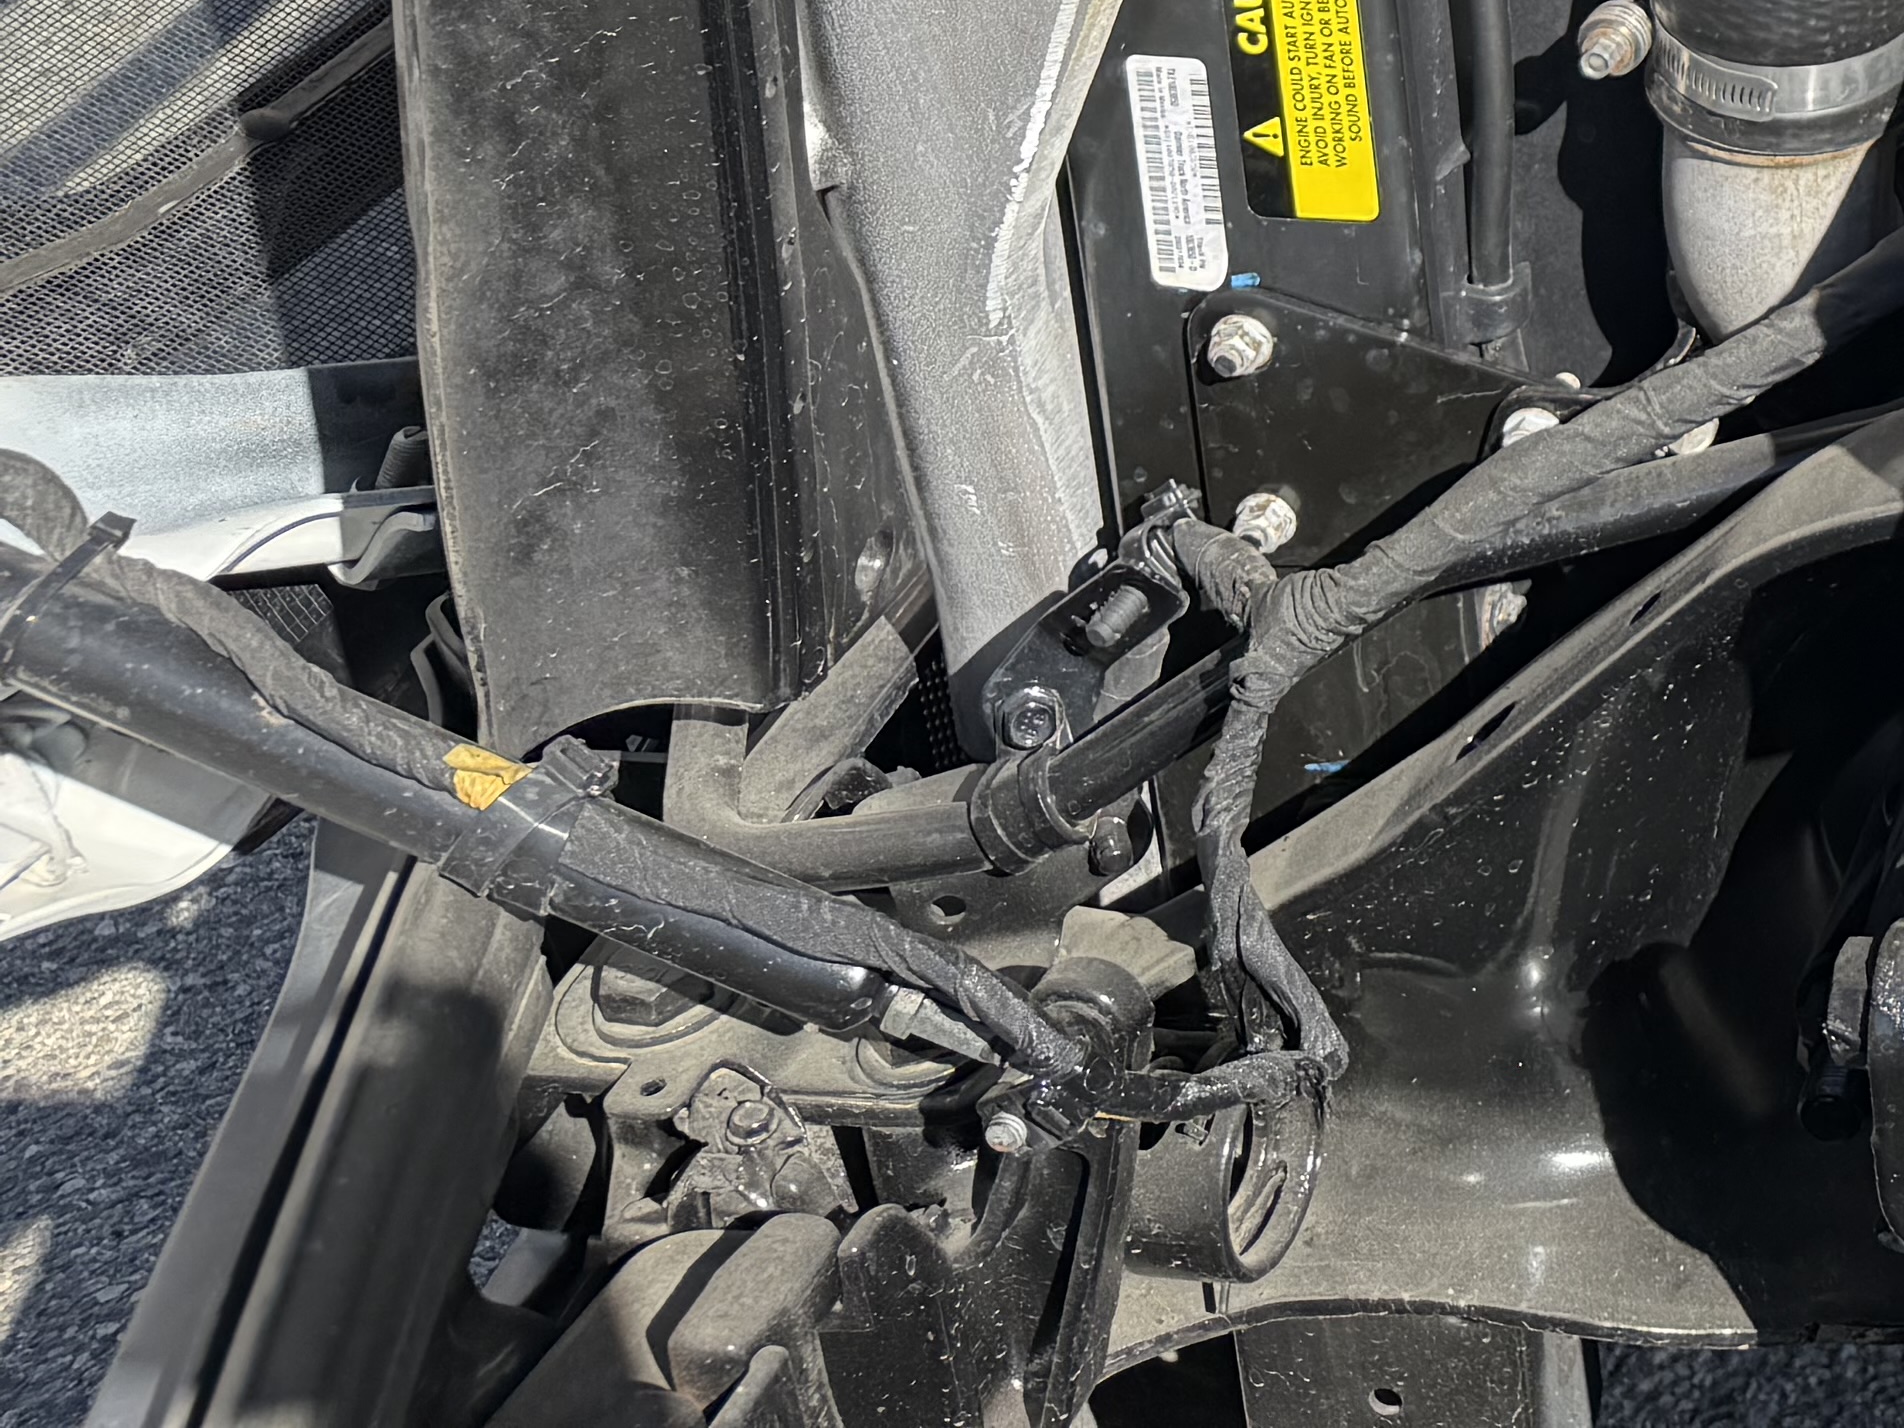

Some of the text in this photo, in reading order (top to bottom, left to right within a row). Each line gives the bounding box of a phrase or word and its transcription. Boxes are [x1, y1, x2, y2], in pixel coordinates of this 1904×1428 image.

[1287, 25, 1301, 63] START
[1306, 30, 1320, 68] TURN
[1320, 16, 1332, 39] OR
[1322, 42, 1337, 69] FAN
[1342, 39, 1357, 92] BEFORE
[1292, 66, 1307, 111] COULD
[1311, 71, 1326, 121] INJURY,
[1326, 72, 1340, 96] ON
[1297, 113, 1313, 167] ENGINE
[1331, 100, 1348, 168] WORKING
[1349, 96, 1362, 142] SOUND
[1317, 125, 1331, 167] AVOID
